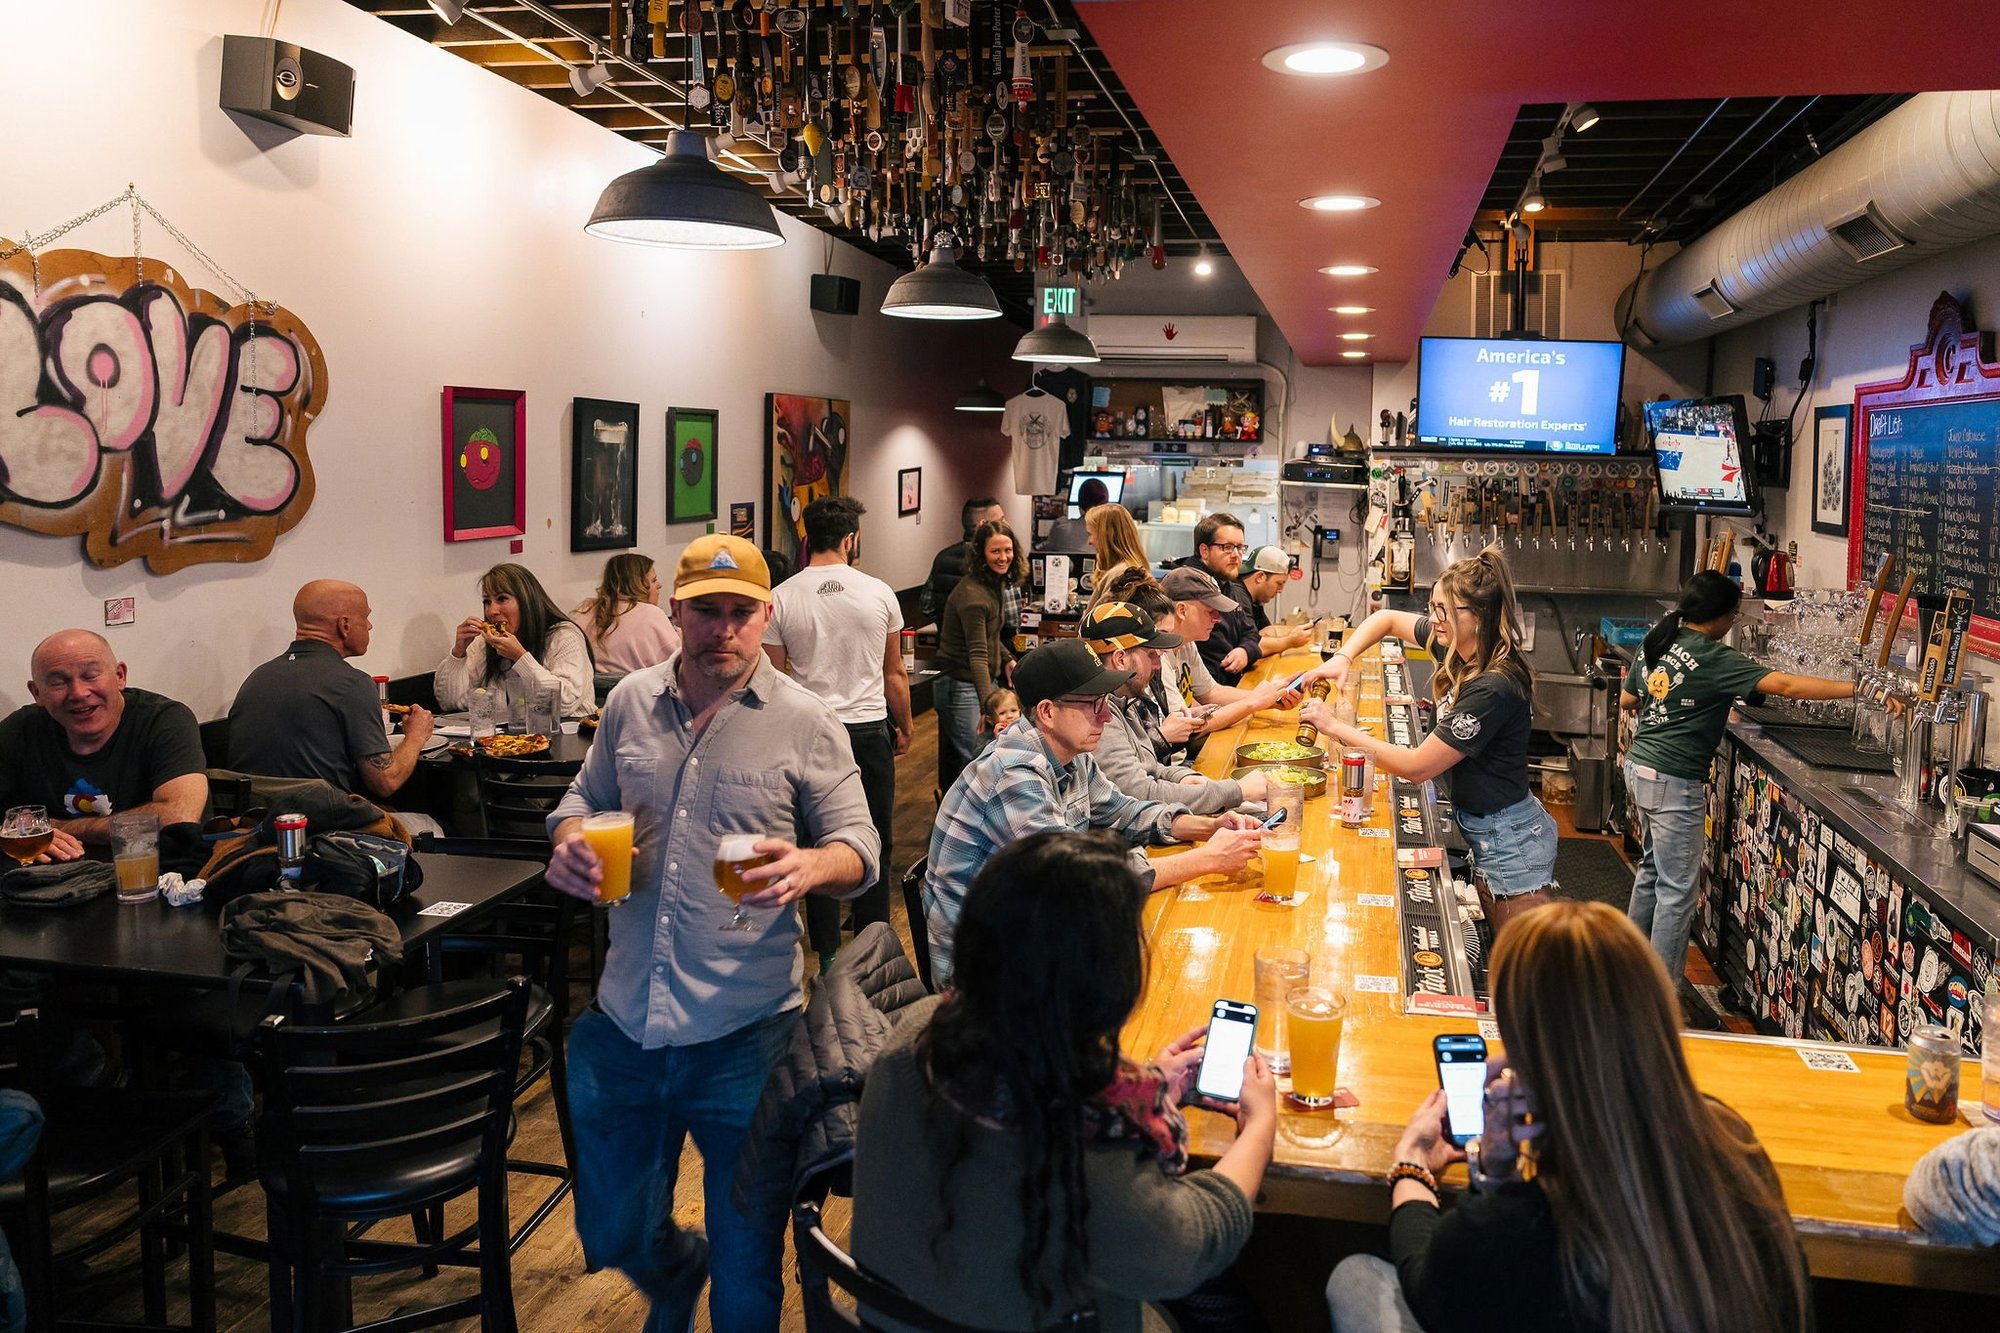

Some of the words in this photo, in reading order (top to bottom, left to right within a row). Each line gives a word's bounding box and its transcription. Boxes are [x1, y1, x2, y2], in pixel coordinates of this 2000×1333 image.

[992, 6, 1001, 31] Porter
[992, 32, 1003, 48] Java
[992, 49, 1002, 76] Vanilla
[1043, 287, 1076, 314] EXIT
[1476, 348, 1566, 365] America's
[1488, 369, 1540, 415] #1
[1448, 416, 1472, 427] Hair
[1473, 417, 1539, 430] Restoration
[1660, 654, 1681, 671] ANCE
[1669, 643, 1700, 671] EACH
[1405, 879, 1434, 903] Tito's
